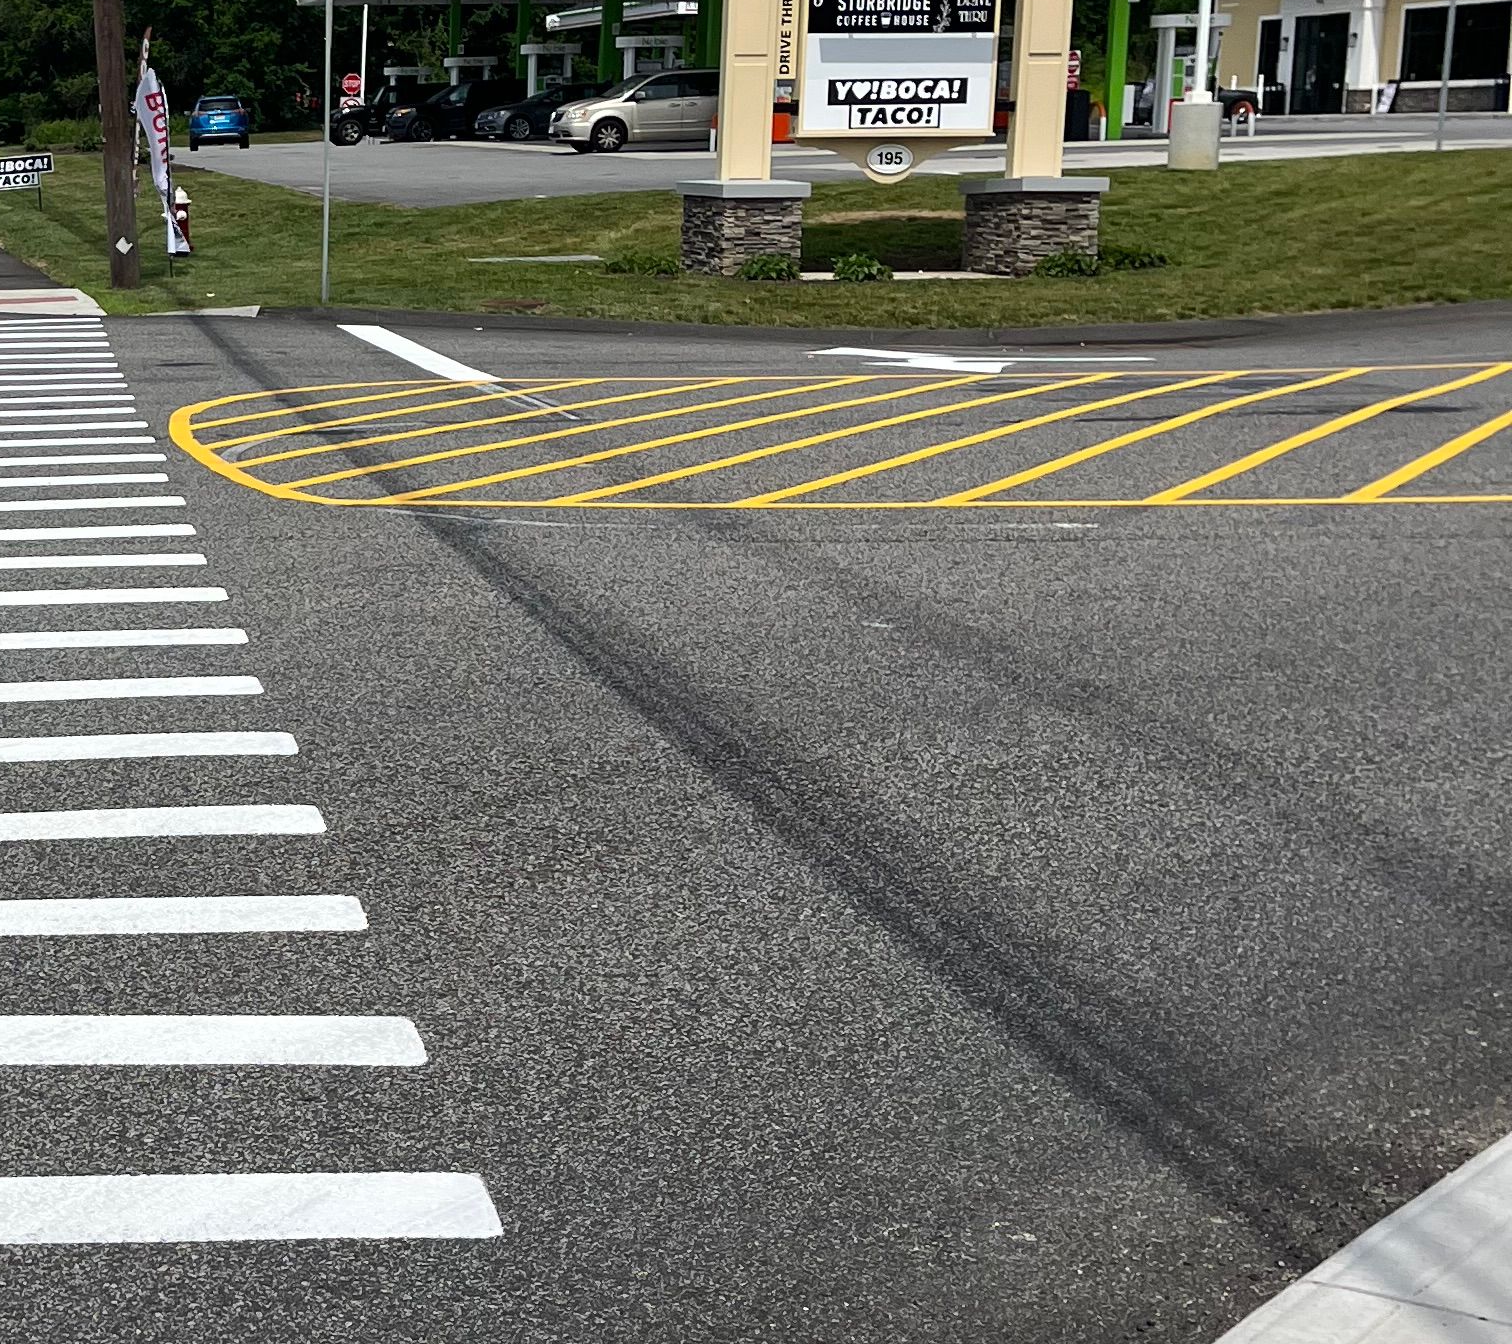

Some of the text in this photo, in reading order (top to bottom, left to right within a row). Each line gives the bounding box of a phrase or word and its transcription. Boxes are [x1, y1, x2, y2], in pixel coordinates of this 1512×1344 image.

[836, 14, 929, 26] COFFEE HOUSE
[958, 10, 988, 23] THRU
[779, 30, 792, 75] DRIVE
[857, 107, 933, 125] TACO!
[877, 151, 903, 165] 195
